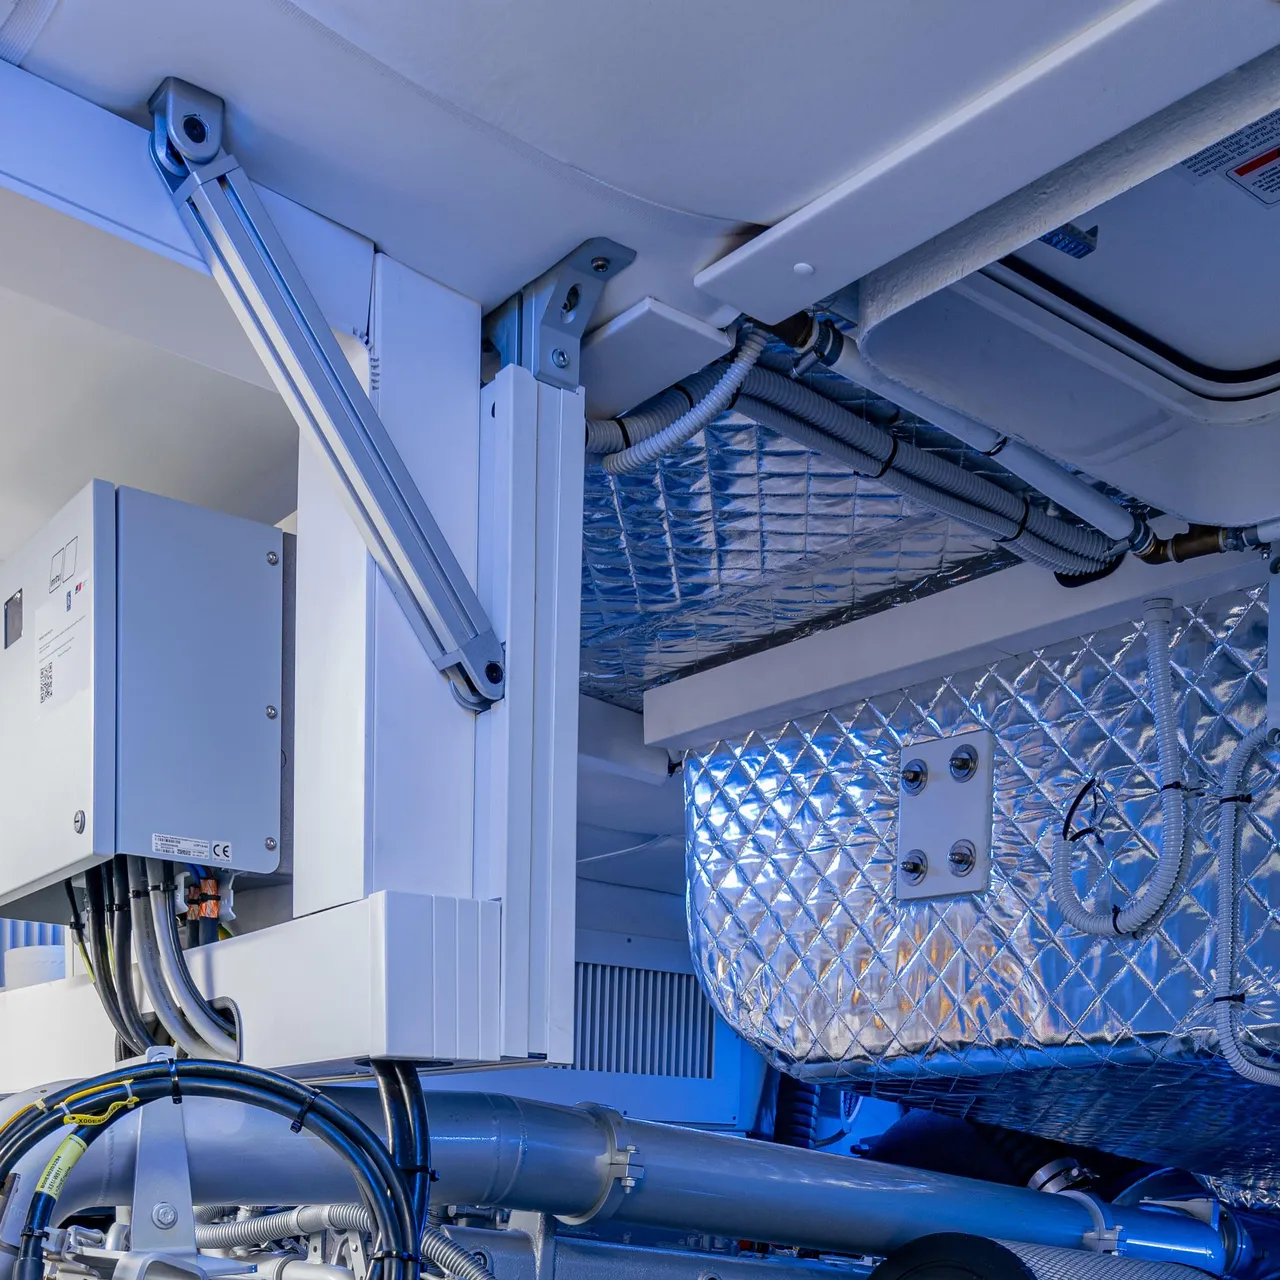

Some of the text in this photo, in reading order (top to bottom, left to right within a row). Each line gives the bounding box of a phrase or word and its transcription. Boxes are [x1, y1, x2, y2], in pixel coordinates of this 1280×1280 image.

[1185, 148, 1224, 169] automatic
[1222, 136, 1245, 150] bilge
[1243, 124, 1269, 139] pump
[1190, 152, 1230, 173] accidental
[1228, 140, 1251, 153] leaks
[1196, 168, 1212, 177] can
[1209, 154, 1239, 171] pollute
[1235, 148, 1250, 157] the
[1248, 134, 1275, 149] waters
[1256, 165, 1279, 177] WITHIN
